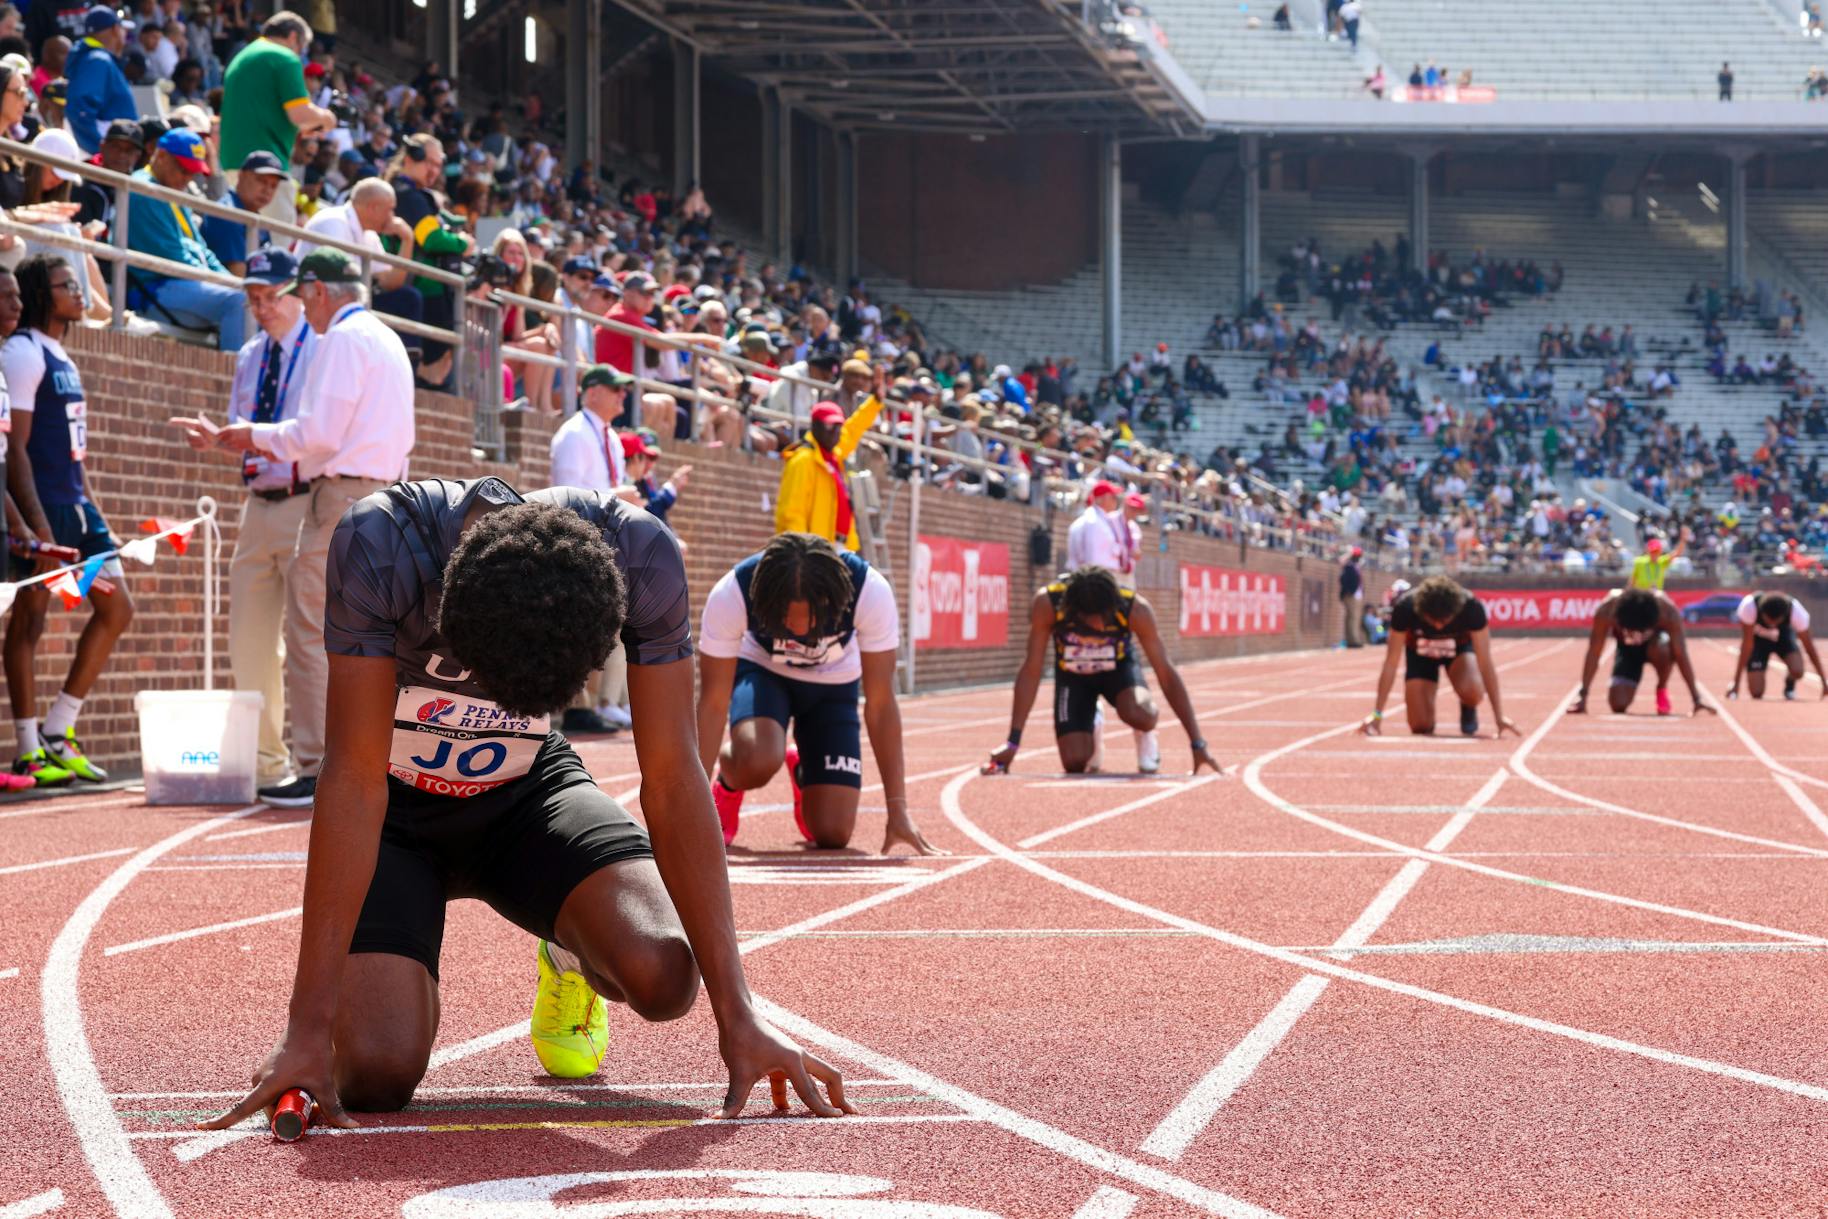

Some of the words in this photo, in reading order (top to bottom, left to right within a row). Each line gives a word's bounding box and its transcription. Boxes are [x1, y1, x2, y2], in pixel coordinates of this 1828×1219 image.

[1482, 598, 1541, 621] YOTA
[416, 725, 455, 738] Dream
[458, 717, 531, 731] RELAYS
[410, 740, 507, 777] JO
[423, 777, 505, 797] TOYOT
